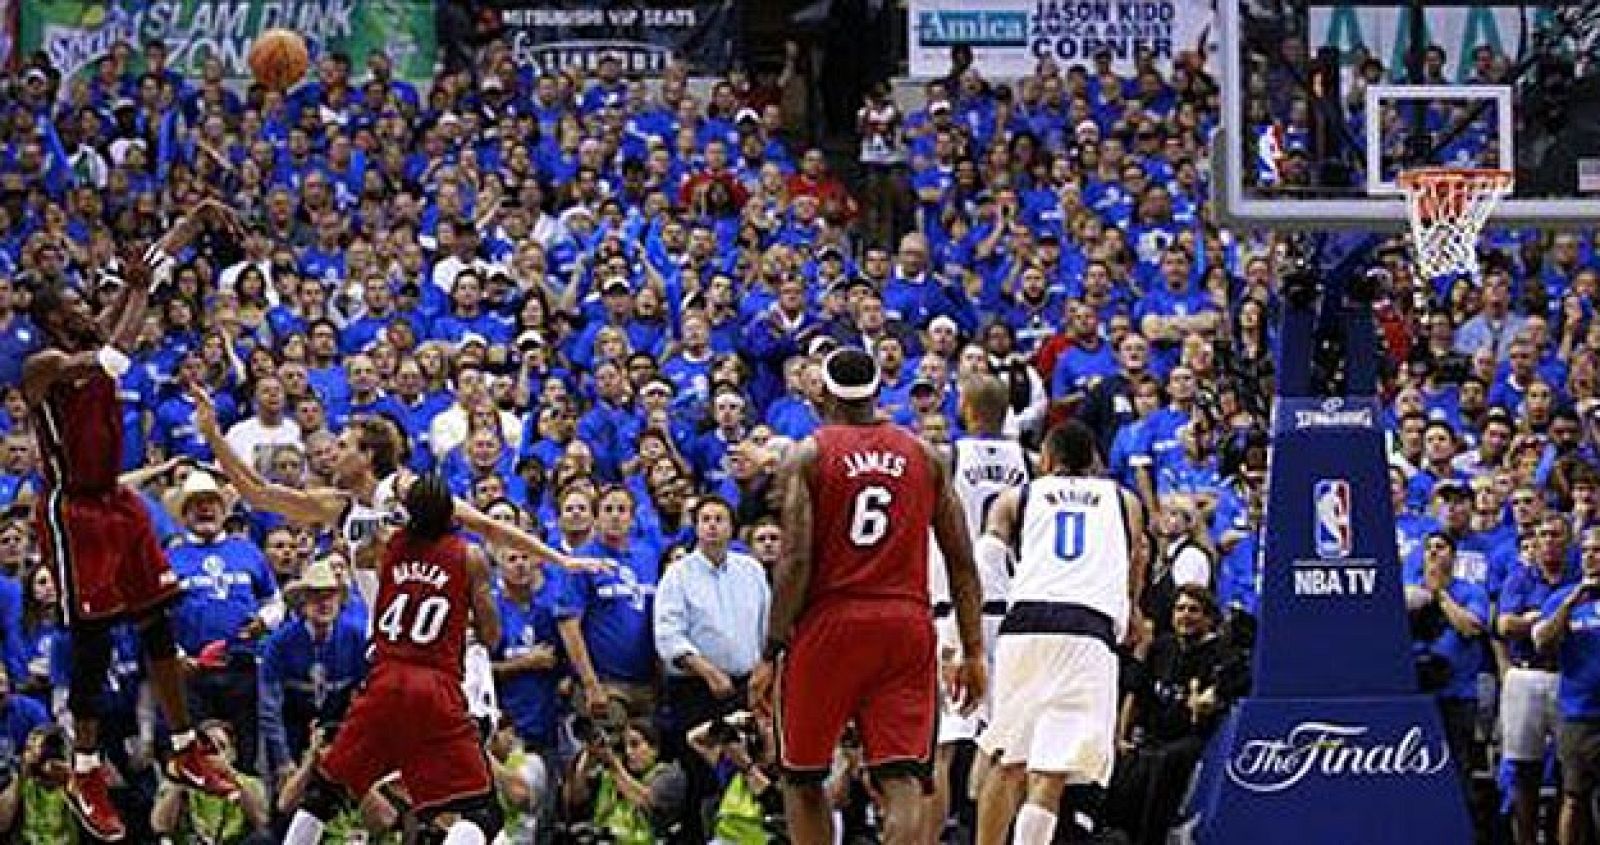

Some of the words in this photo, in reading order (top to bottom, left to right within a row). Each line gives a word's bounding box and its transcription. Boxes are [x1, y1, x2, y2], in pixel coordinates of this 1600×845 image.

[1032, 2, 1110, 21] JASON
[1118, 2, 1175, 21] KIDD
[920, 15, 1023, 42] Amica
[1032, 38, 1173, 58] CORNER
[844, 450, 907, 479] JAMES
[850, 486, 892, 547] 6
[1054, 511, 1086, 561] 0
[1294, 568, 1343, 595] NBA
[1345, 568, 1377, 595] TV
[378, 593, 450, 643] 40
[1236, 738, 1298, 775] The
[1287, 721, 1448, 782] Finals
